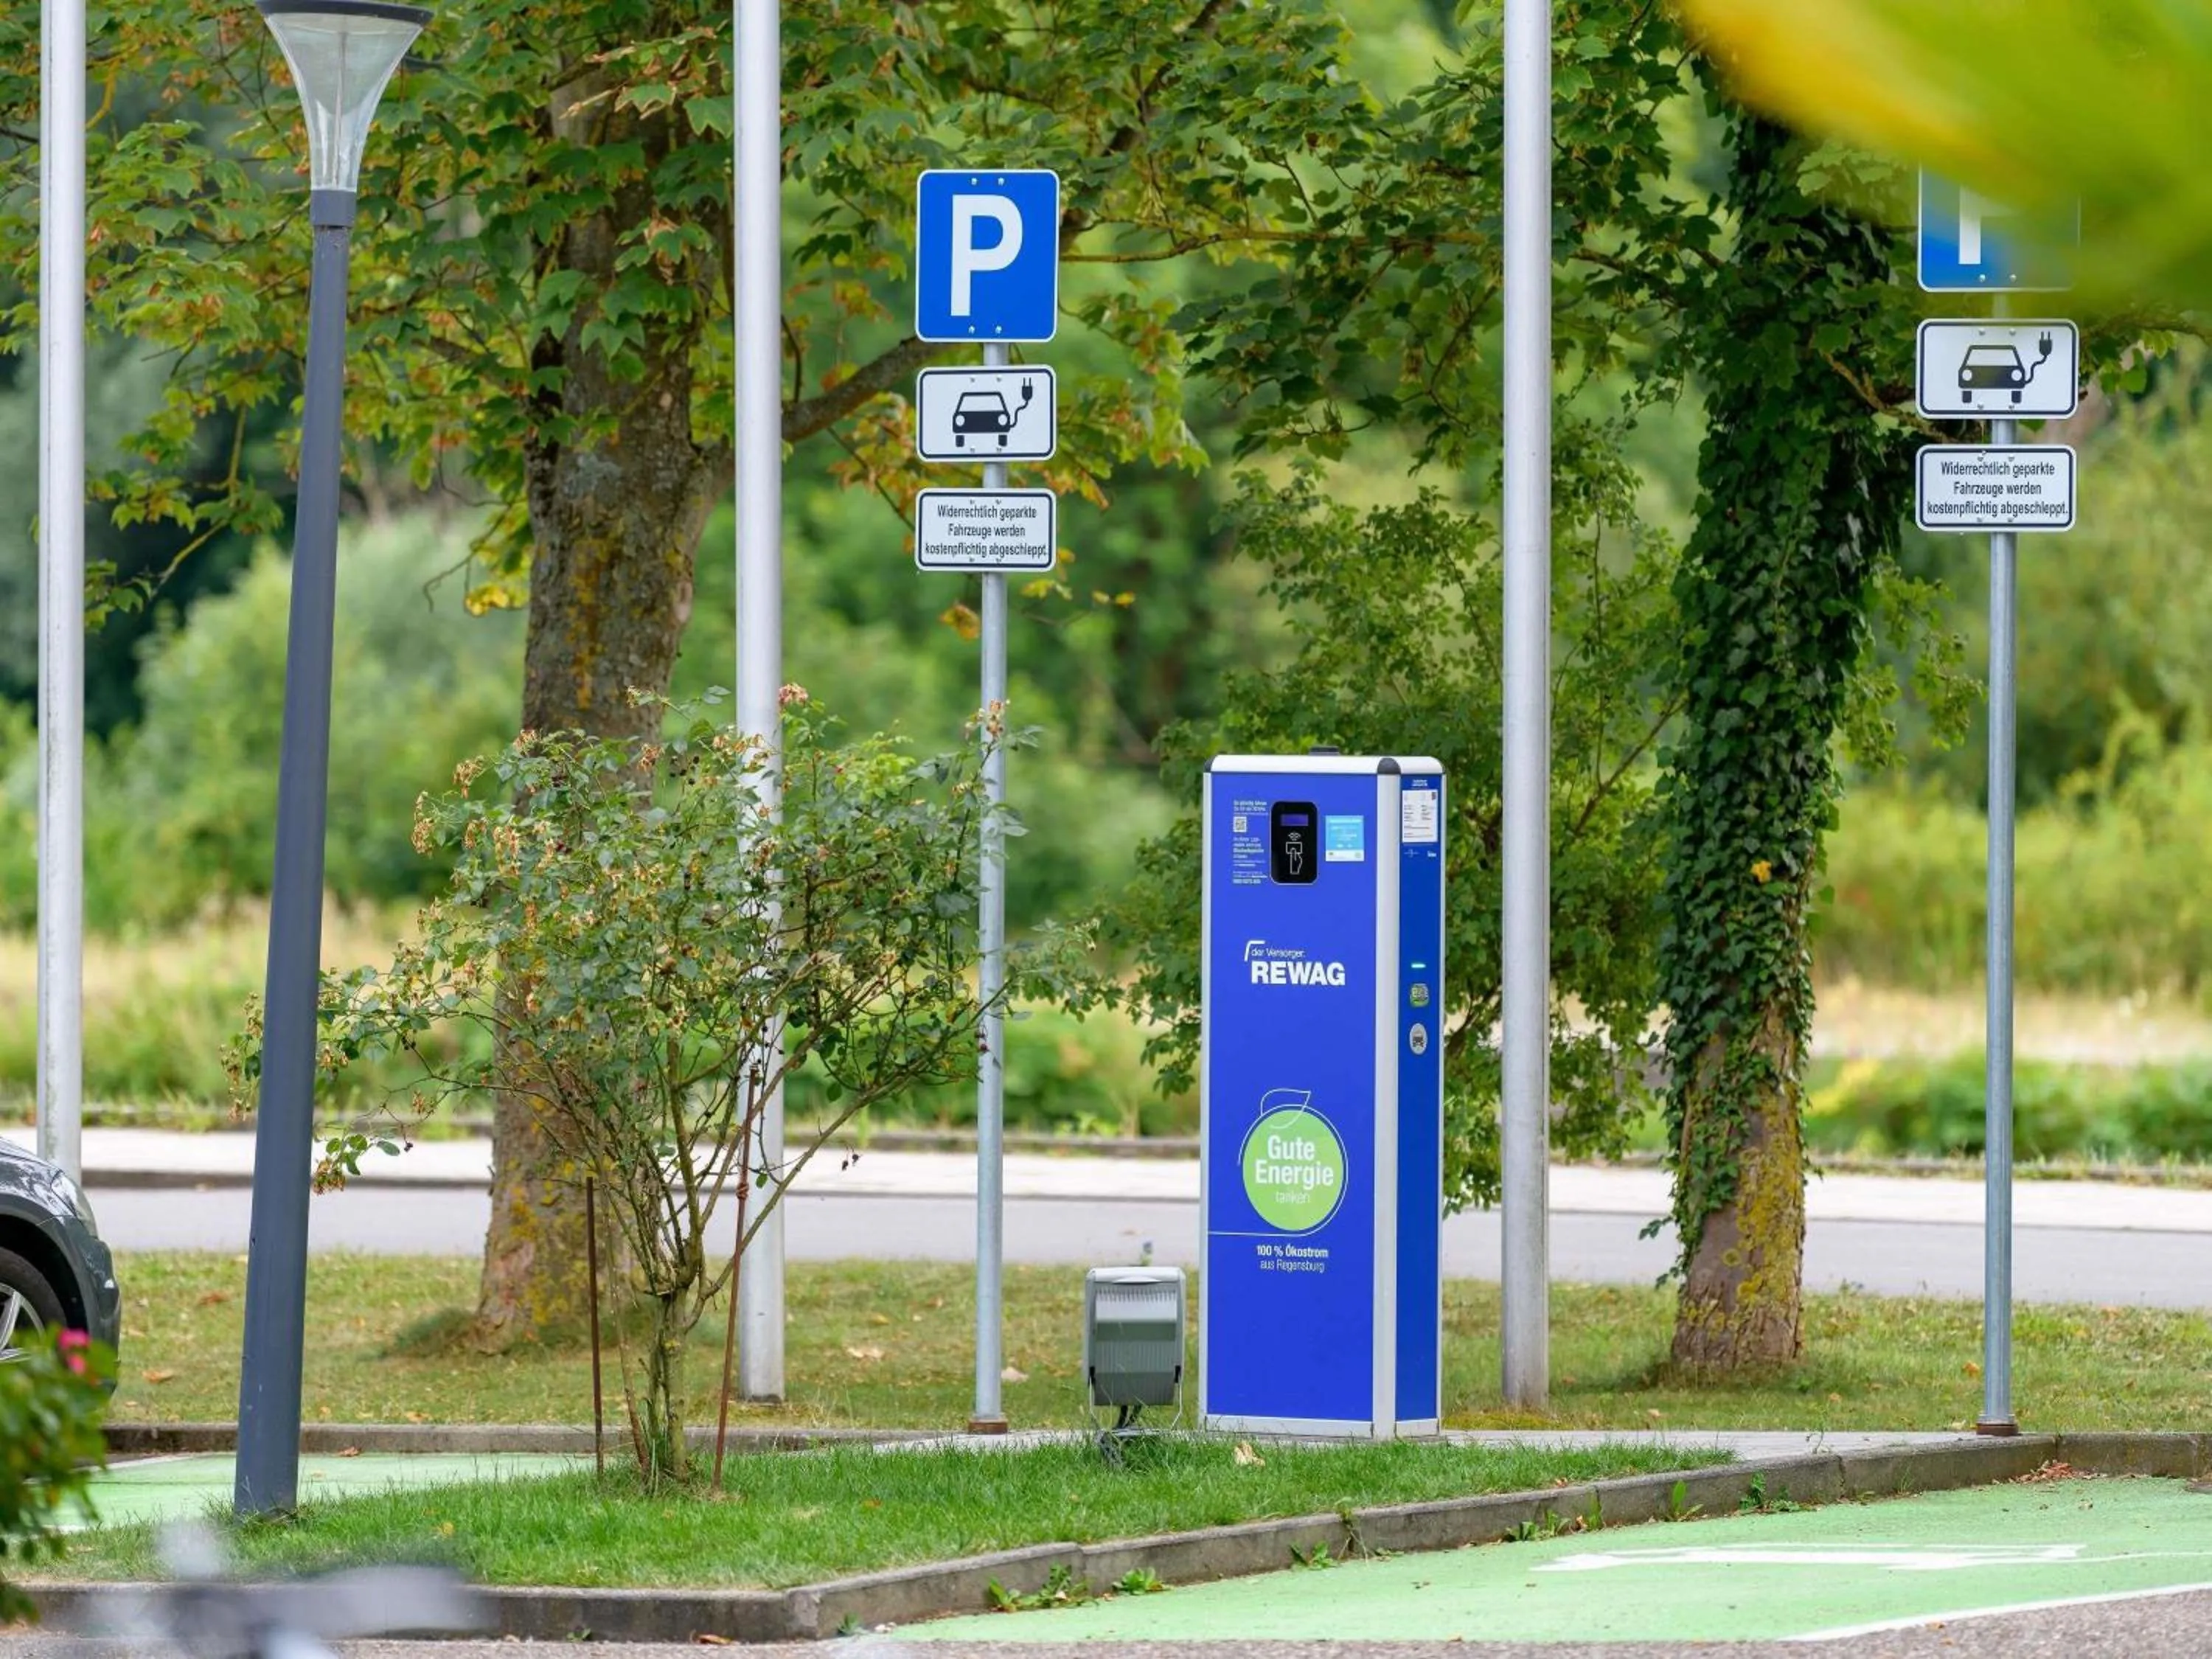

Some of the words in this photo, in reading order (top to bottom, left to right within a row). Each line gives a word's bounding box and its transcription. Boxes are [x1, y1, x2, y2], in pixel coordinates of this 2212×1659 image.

[950, 194, 1023, 316] P
[1941, 461, 2011, 476] Widerrechtlich
[2012, 462, 2055, 478] geparkte
[1953, 481, 2003, 498] Fahrzeuge
[2006, 481, 2042, 495] werden
[937, 504, 998, 518] Widerrechtlich
[999, 504, 1037, 521] geparkte
[1927, 501, 1997, 518] kostenpflichtig
[2000, 501, 2068, 518] abgeschleppt.
[947, 523, 992, 539] Fahrzeuge
[994, 524, 1026, 537] werden
[925, 542, 987, 558] kostenpflichtig
[1251, 947, 1264, 956] der
[1251, 961, 1346, 985] REWAG
[1267, 1134, 1315, 1161] Gute
[1256, 1158, 1334, 1190] Energie
[1275, 1191, 1310, 1204] tanken
[1256, 1244, 1272, 1256] 100
[1273, 1245, 1284, 1257] %
[1285, 1243, 1329, 1258] Ökostrom
[1260, 1260, 1274, 1270] aus
[1276, 1259, 1325, 1273] Regensburg
